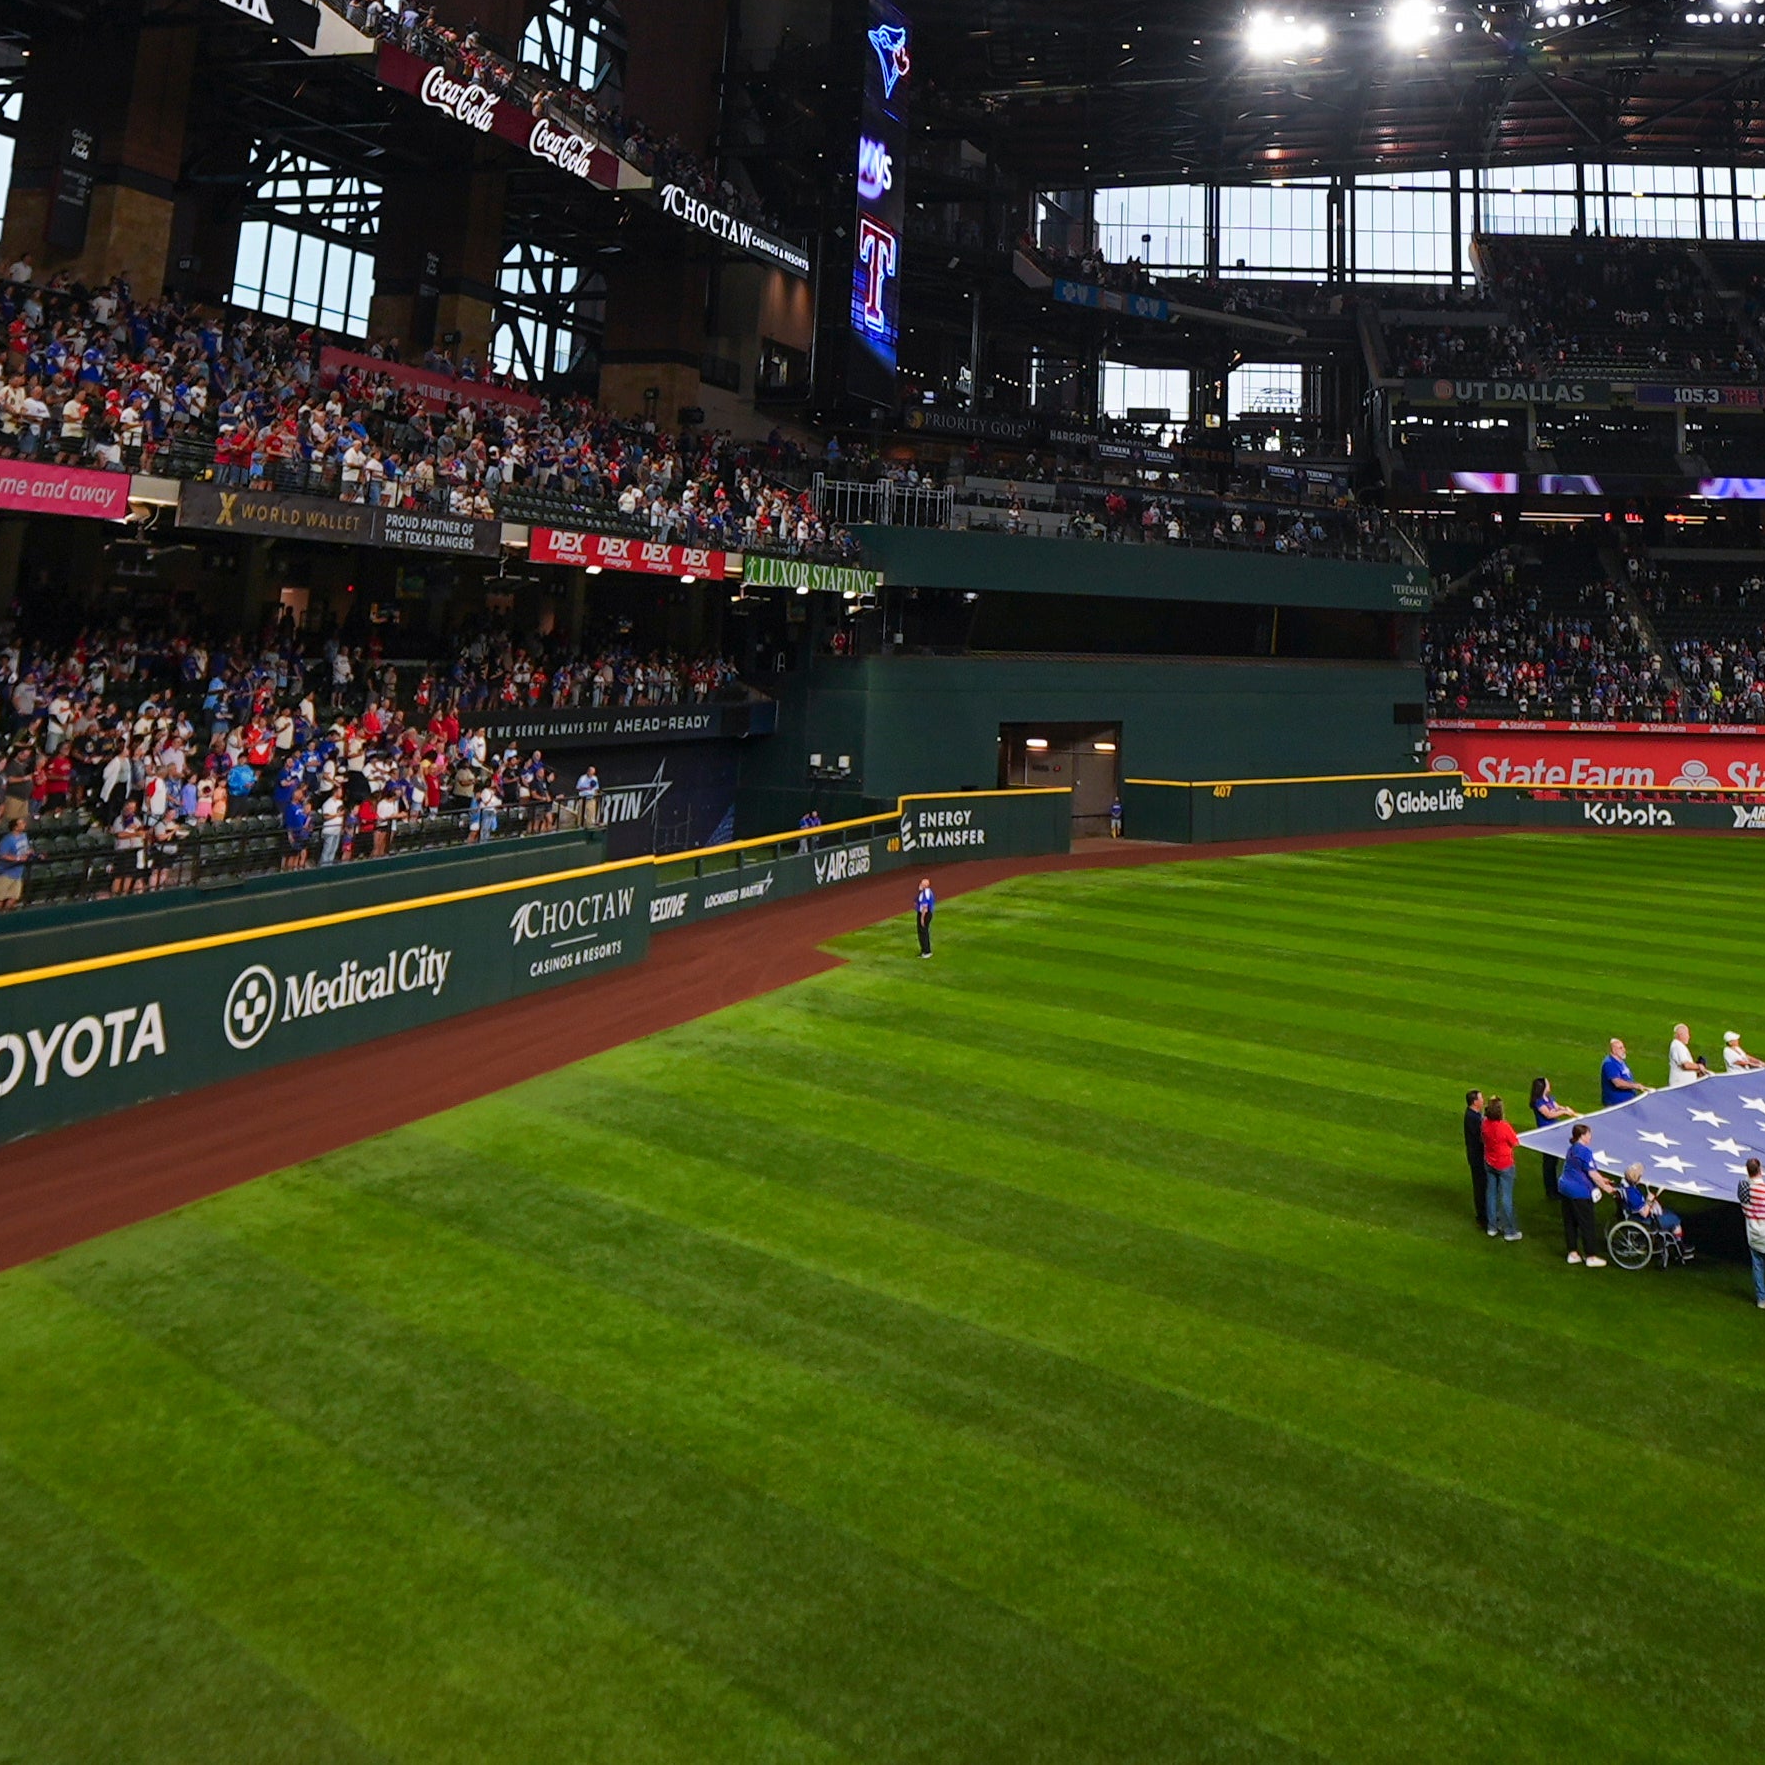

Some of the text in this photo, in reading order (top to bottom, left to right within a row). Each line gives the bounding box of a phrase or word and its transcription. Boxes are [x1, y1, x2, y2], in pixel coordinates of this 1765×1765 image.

[420, 64, 501, 134] Coca-Cola
[528, 117, 597, 179] Coca-Cola
[875, 151, 894, 191] VS
[670, 185, 754, 249] CHOCTAW
[859, 218, 897, 333] T
[1455, 381, 1586, 403] UT DALLAS
[1673, 387, 1720, 405] 105.3
[924, 413, 988, 434] PRIORITY
[31, 478, 69, 500] and
[69, 486, 117, 509] away
[241, 503, 361, 532] WORLD WALLET
[385, 512, 475, 536] PROUD PARTNER OF
[384, 528, 476, 552] THE TEXAS RANGERS
[548, 529, 711, 568] DEX DEX DEX DEX
[555, 550, 711, 578] imaging imaging imaging imaging
[758, 559, 876, 594] LUXOR STAFFING
[495, 724, 512, 739] WE
[514, 723, 546, 739] SERVE
[547, 721, 584, 737] ALWAYS
[586, 720, 609, 734] STAY
[613, 715, 661, 734] AHEAD
[668, 714, 711, 732] READY
[1212, 785, 1233, 799] 407
[1462, 785, 1489, 800] 410
[918, 809, 973, 828] ENERGY
[1583, 801, 1675, 827] Kubota
[886, 836, 901, 853] 410
[918, 829, 986, 848] TRANSFER
[825, 850, 848, 884] AIR
[847, 857, 871, 878] GUARD
[703, 883, 766, 910] LOCKHEED MARTIN
[523, 886, 636, 940] CHOCTAW
[529, 939, 623, 978] CASINOS & RESORTS
[281, 944, 452, 1023] Medical City
